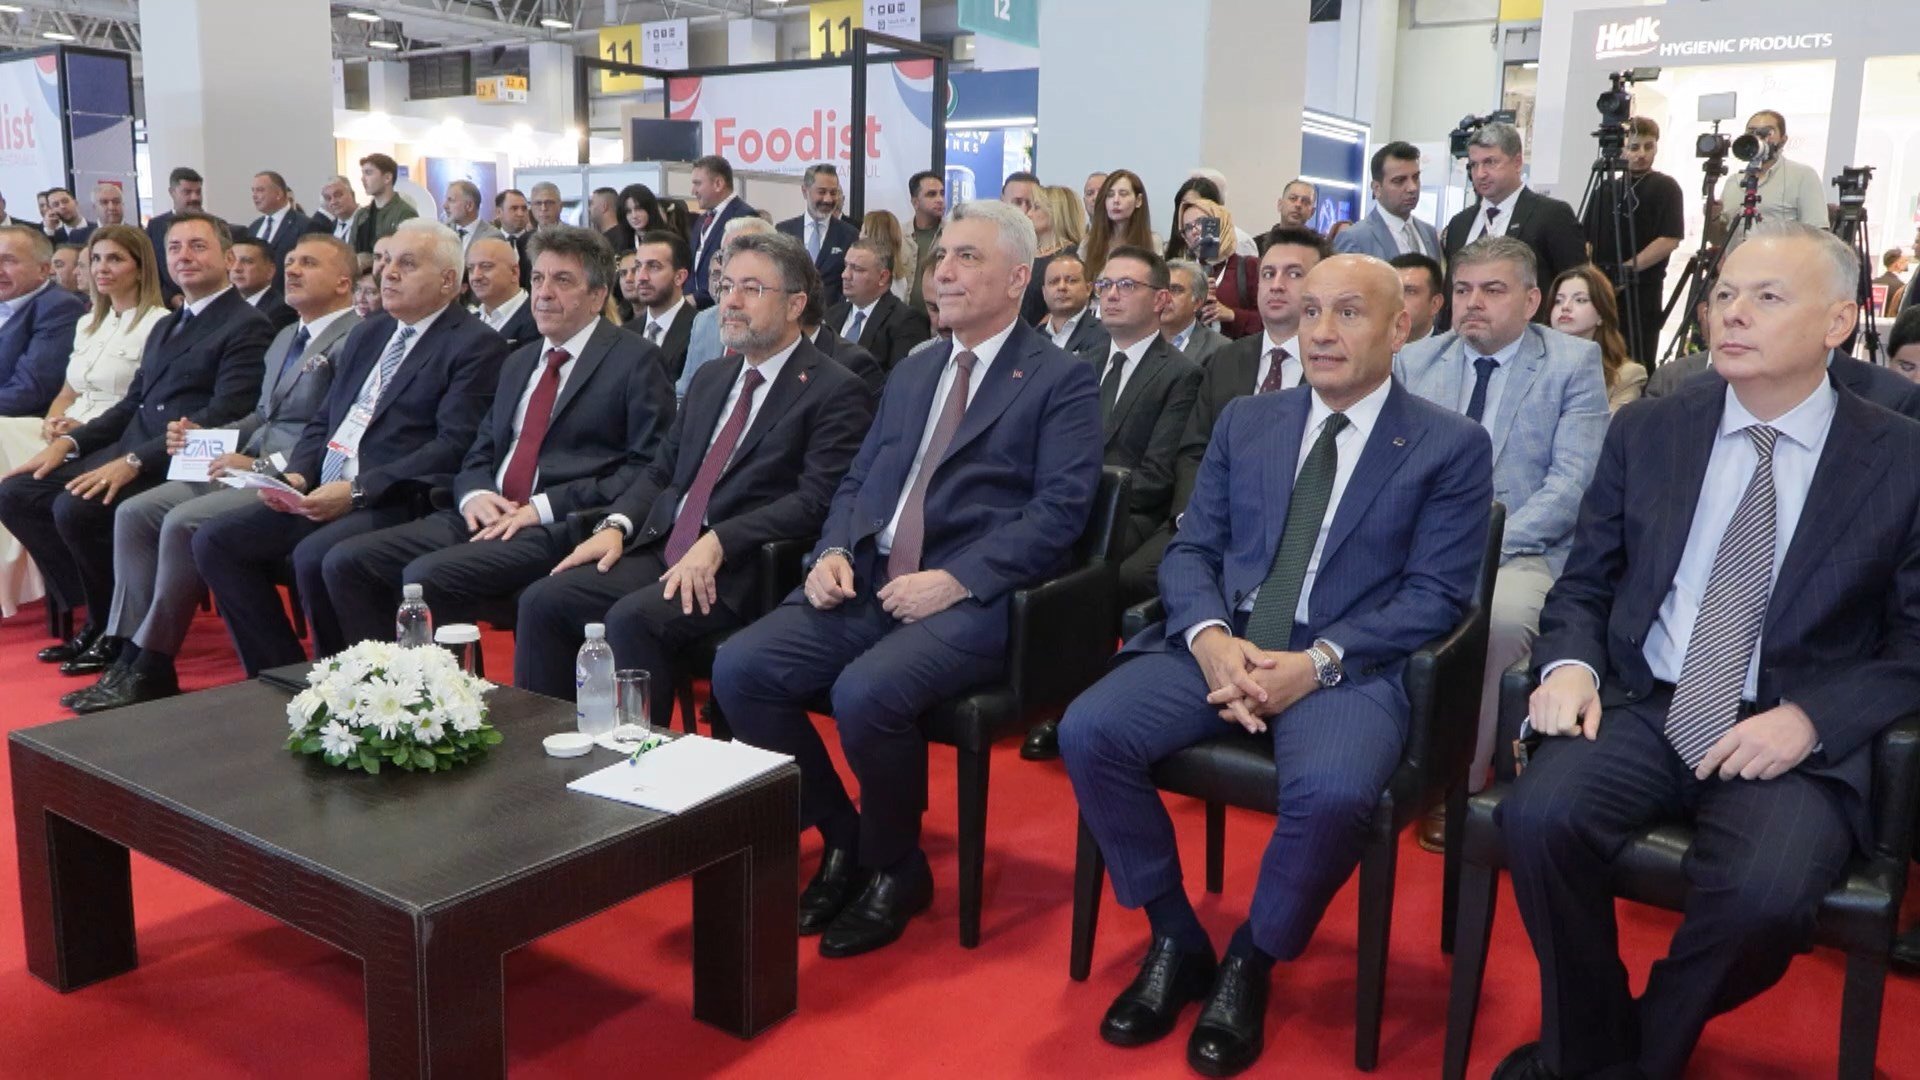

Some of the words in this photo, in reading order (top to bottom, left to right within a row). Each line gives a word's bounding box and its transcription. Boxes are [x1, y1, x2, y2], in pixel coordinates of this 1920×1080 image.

[993, 0, 1010, 20] 12
[818, 16, 854, 59] 11
[1596, 16, 1660, 53] Halk
[1660, 39, 1736, 57] HYGIENIC
[1738, 33, 1832, 52] PRODUCTS
[606, 39, 633, 77] 11
[714, 109, 882, 164] Foodist
